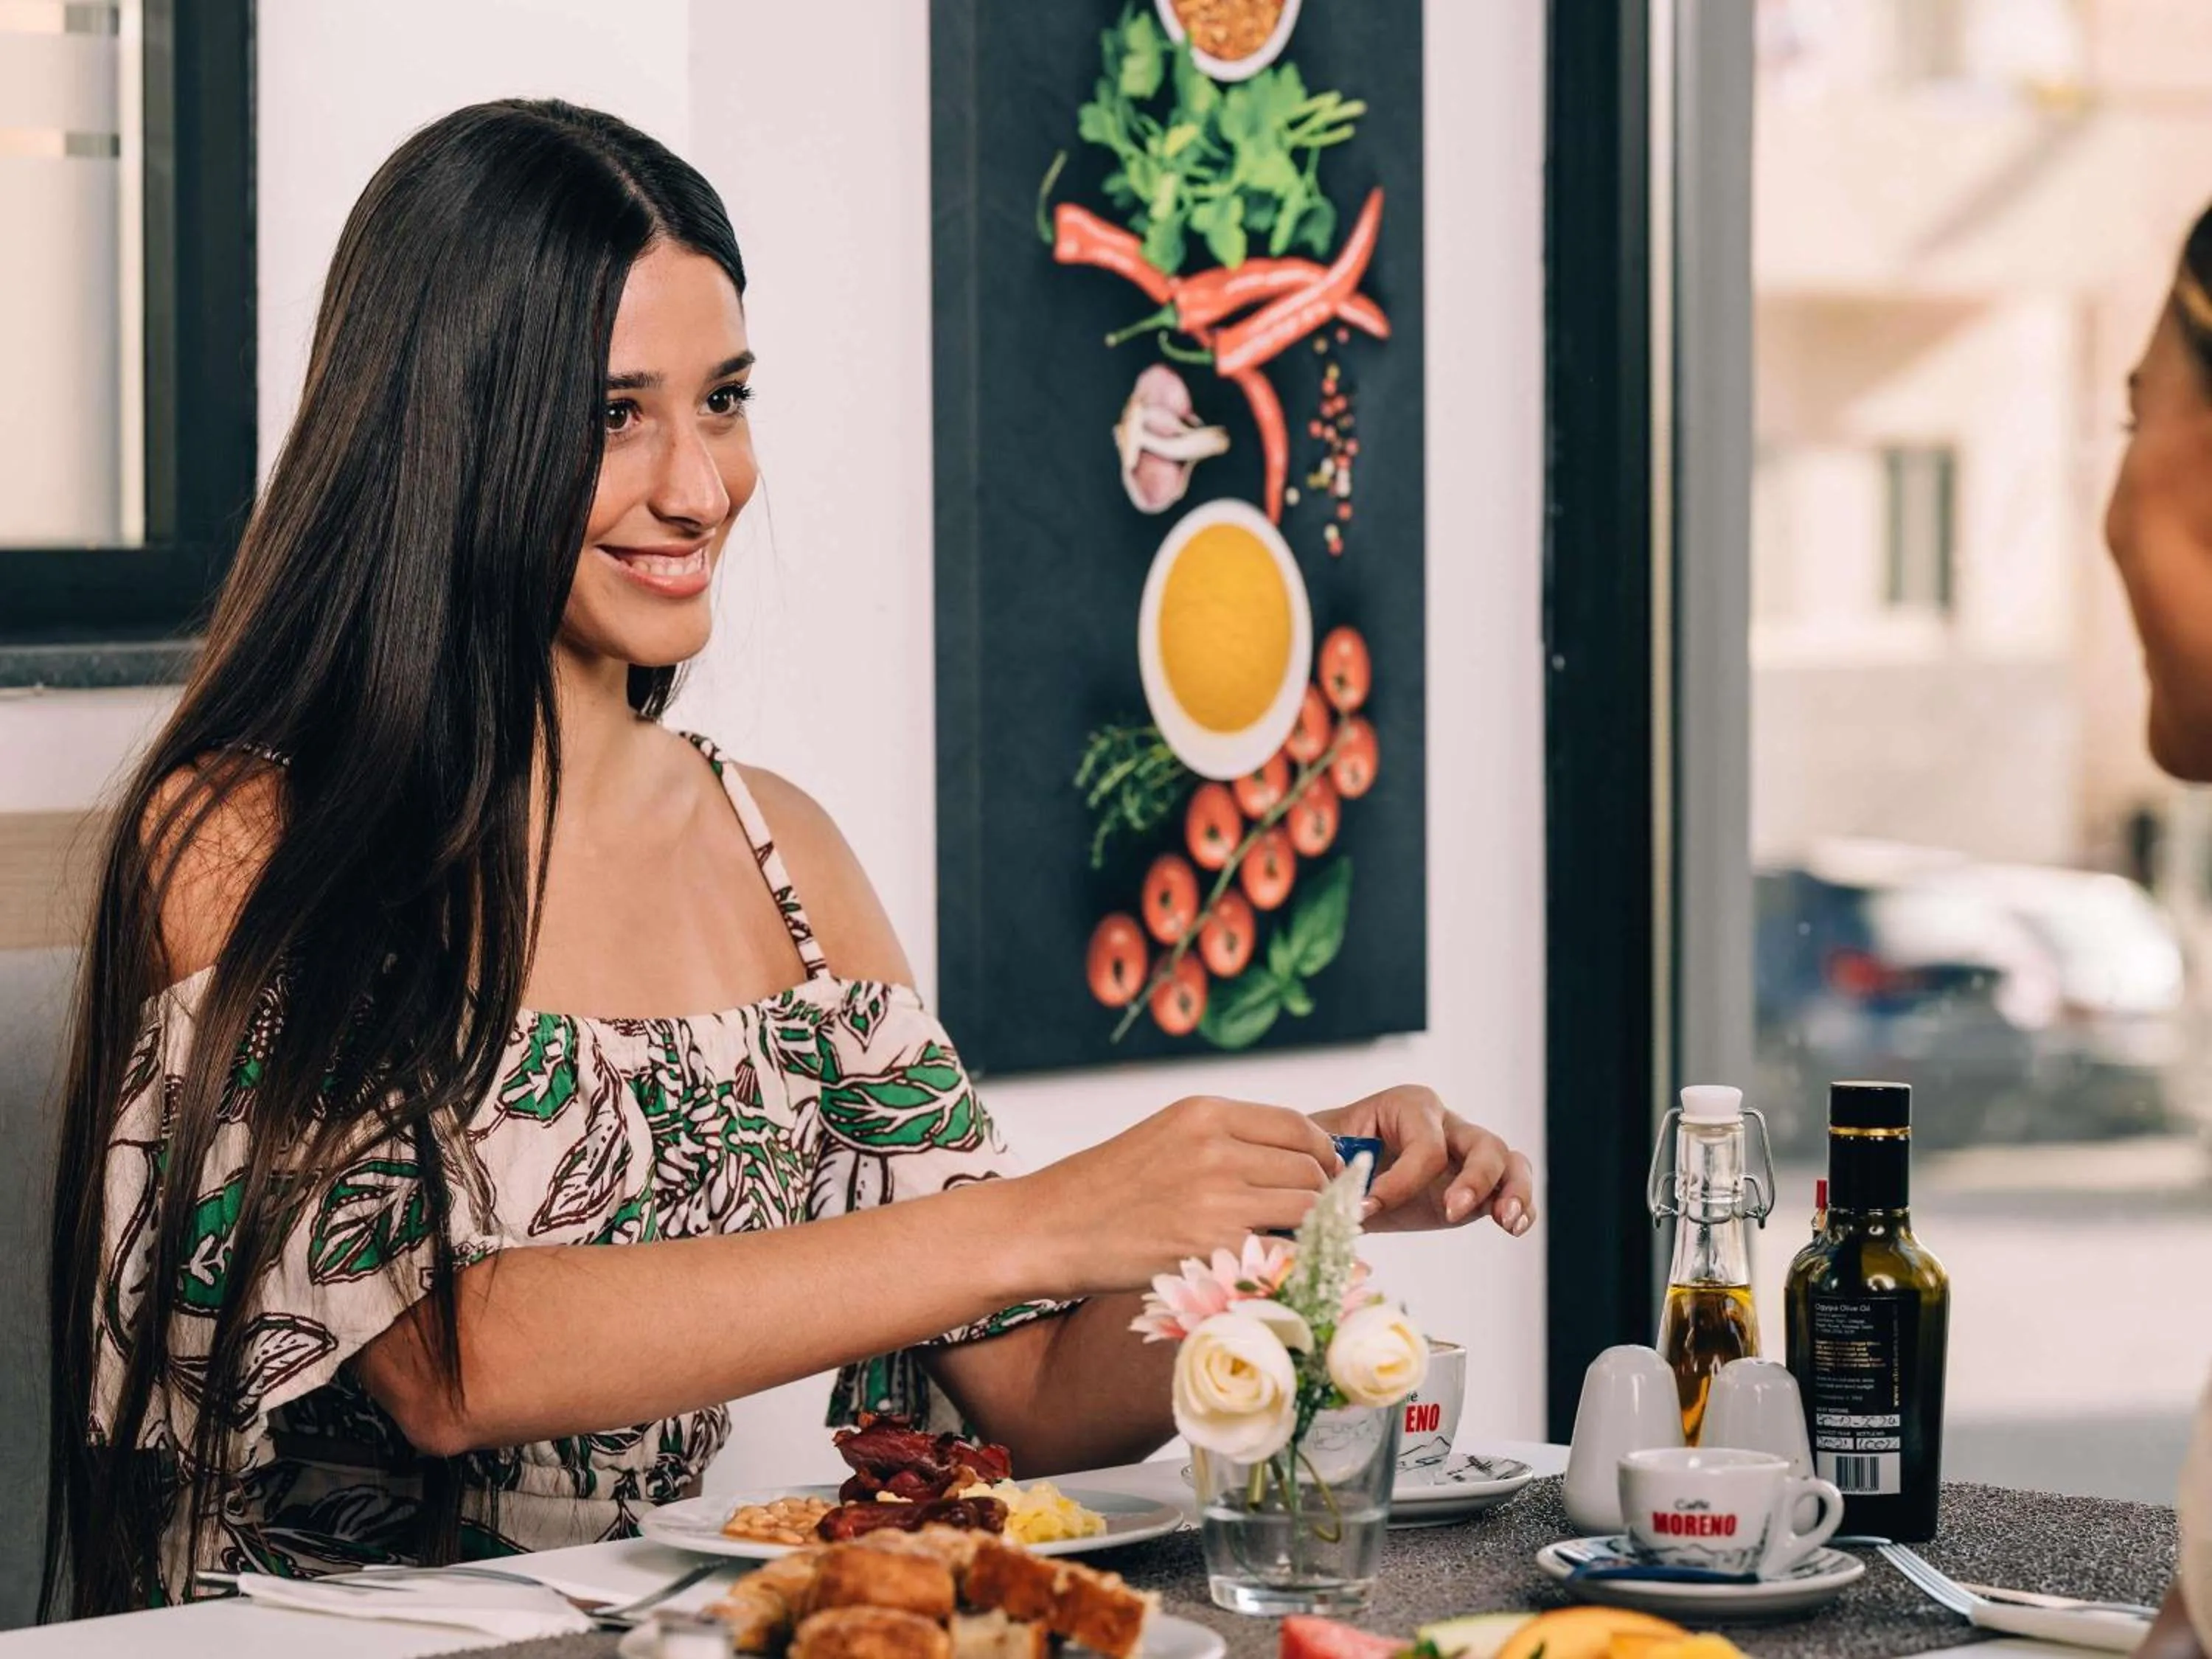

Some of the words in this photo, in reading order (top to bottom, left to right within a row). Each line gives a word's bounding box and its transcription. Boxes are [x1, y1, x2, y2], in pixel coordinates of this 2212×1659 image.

[1860, 1304, 1871, 1312] Oil
[1405, 1404, 1440, 1433] ENO
[1652, 1512, 1736, 1537] MORENO
